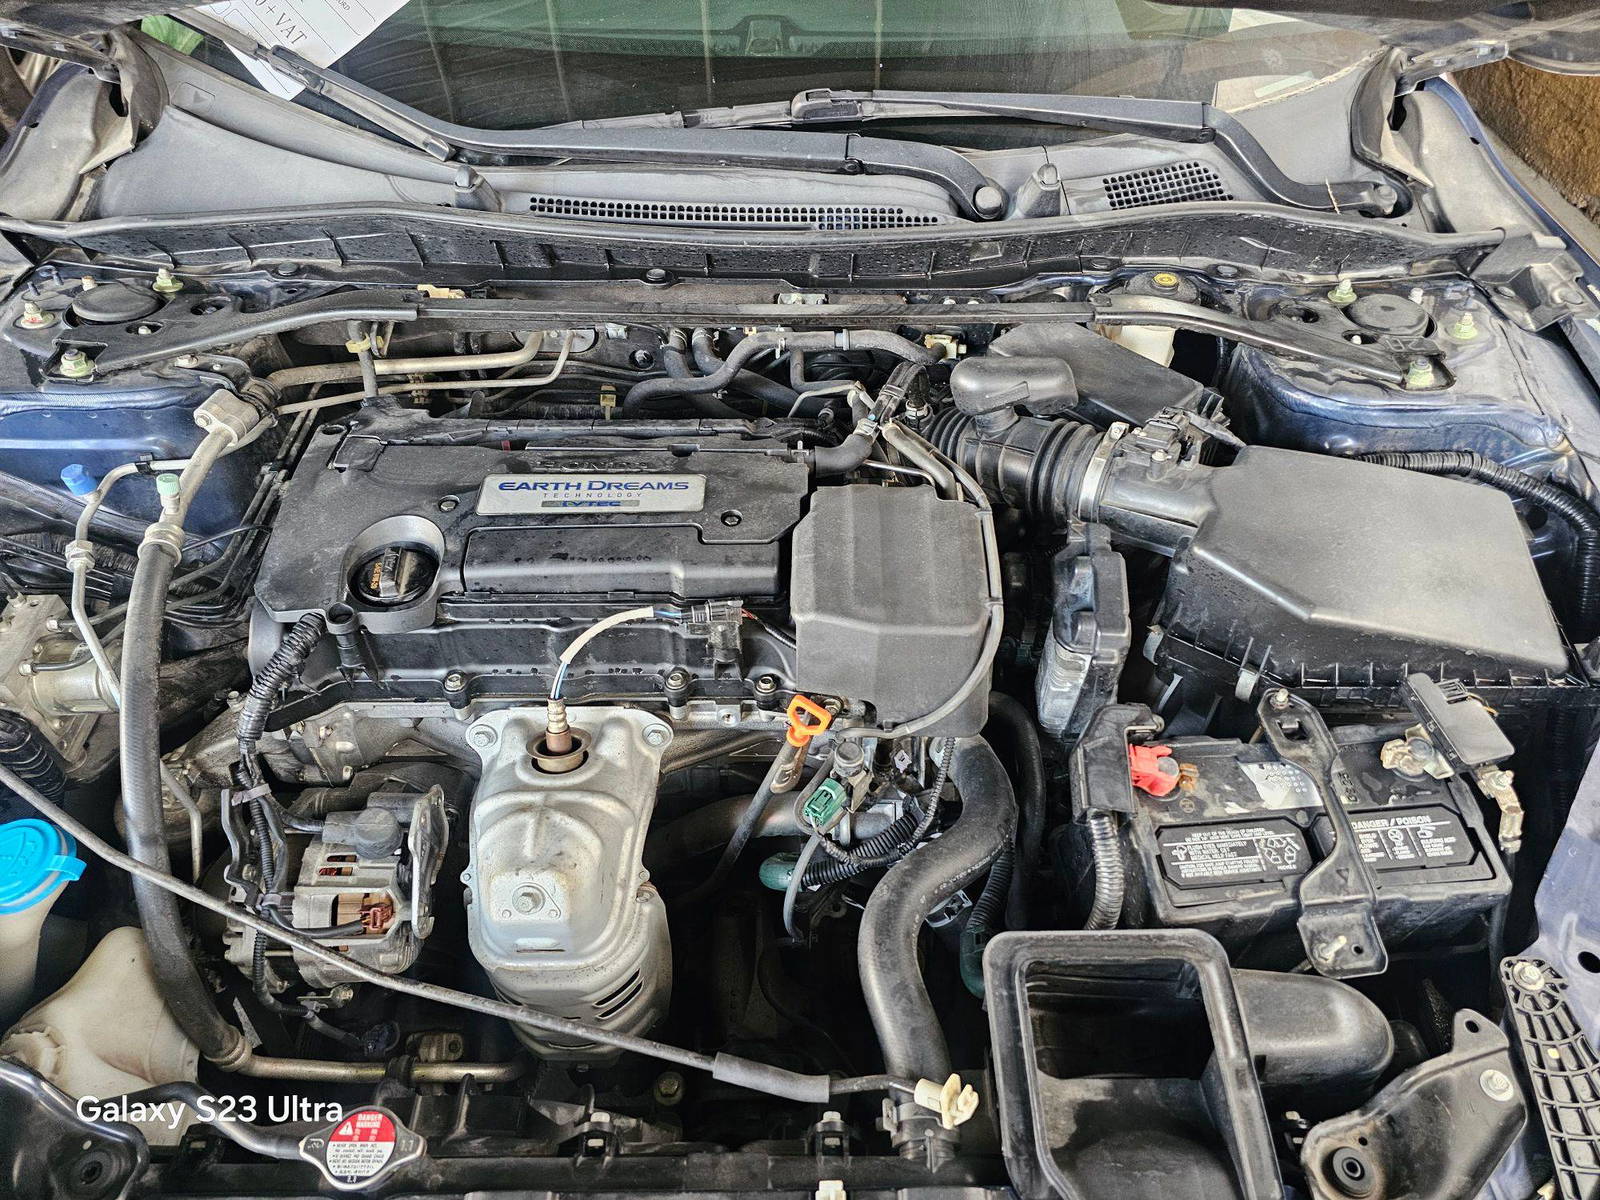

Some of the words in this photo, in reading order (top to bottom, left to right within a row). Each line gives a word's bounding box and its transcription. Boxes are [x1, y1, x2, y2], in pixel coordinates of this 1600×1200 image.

[275, 12, 308, 45] VAT
[498, 481, 582, 491] EARTH
[587, 480, 689, 491] DREAMS
[1351, 819, 1389, 830] DANGER
[1396, 815, 1432, 826] POISON
